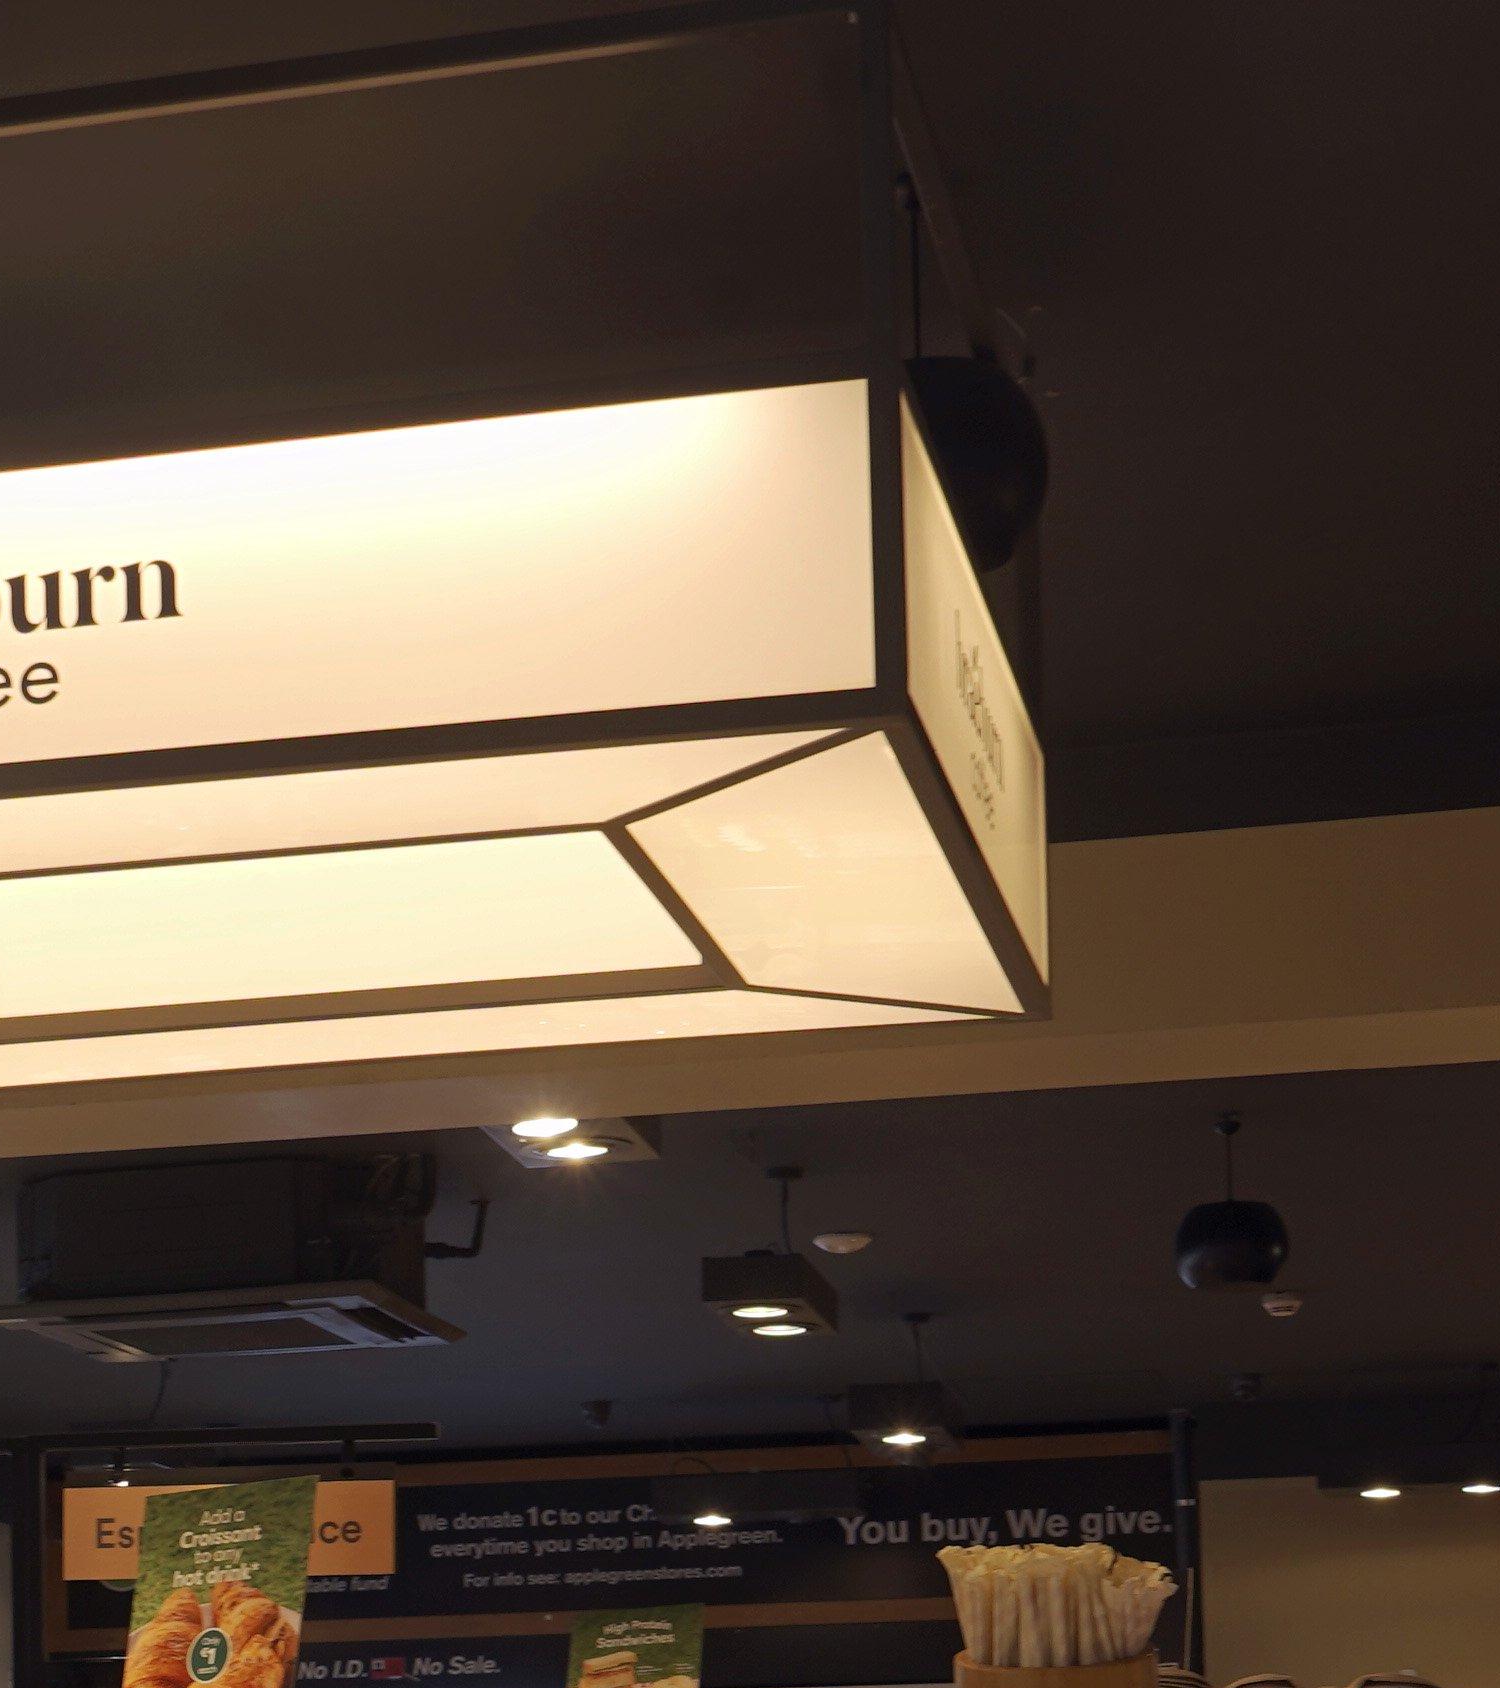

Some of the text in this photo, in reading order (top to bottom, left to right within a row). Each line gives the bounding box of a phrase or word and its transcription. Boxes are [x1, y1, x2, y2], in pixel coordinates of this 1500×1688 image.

[417, 1512, 449, 1532] We
[838, 1504, 1174, 1546] You buy, We give.
[533, 1537, 573, 1556] you
[412, 1657, 445, 1677] No
